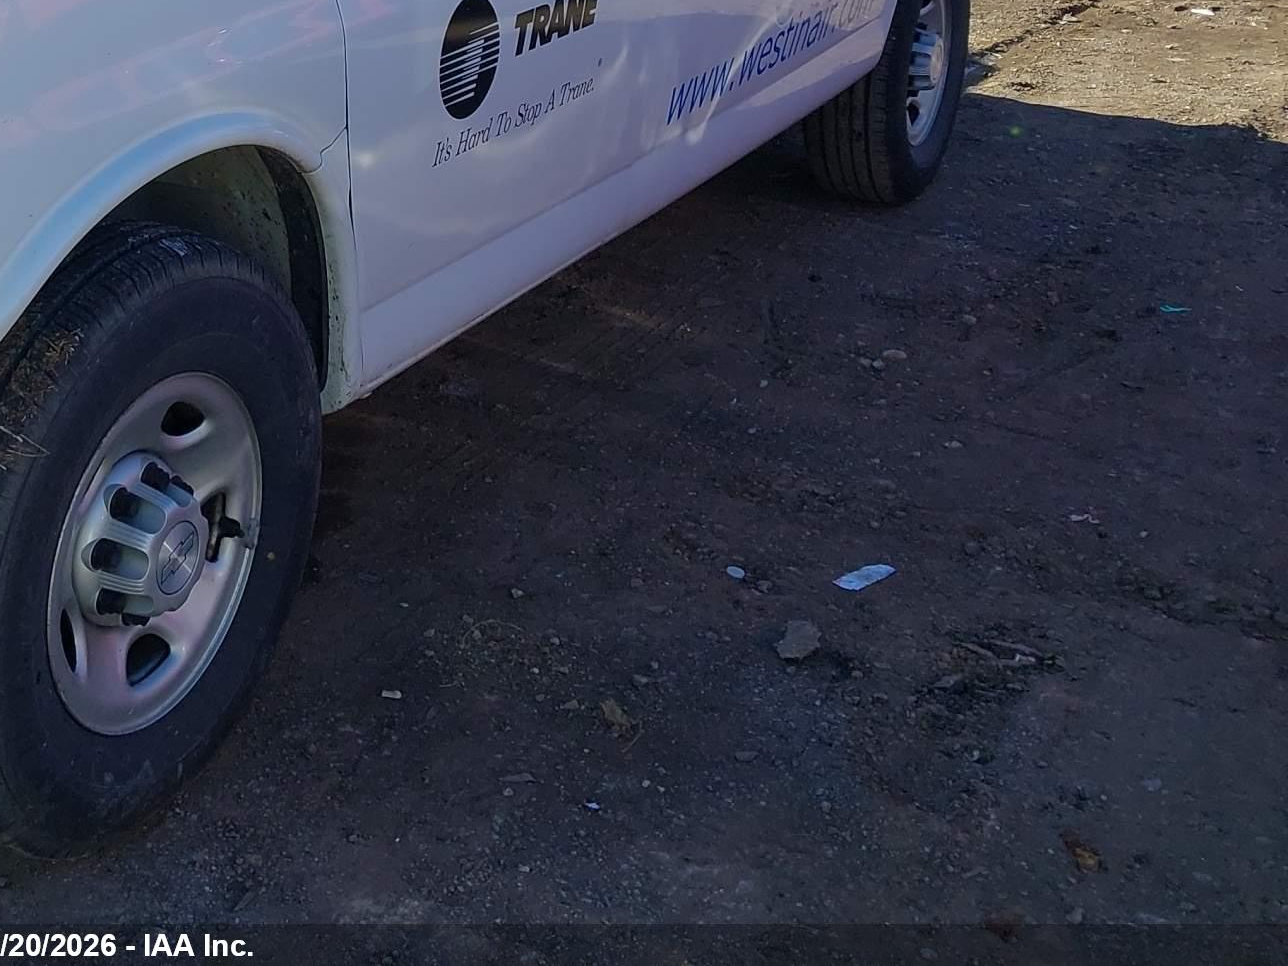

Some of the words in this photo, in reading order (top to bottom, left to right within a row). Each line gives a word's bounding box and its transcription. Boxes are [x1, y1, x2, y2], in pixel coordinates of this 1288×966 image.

[432, 137, 451, 167] It's
[456, 118, 493, 156] Hard
[496, 111, 511, 136] To
[515, 98, 542, 127] Stop
[544, 92, 555, 114] A
[560, 77, 595, 106] Trane.
